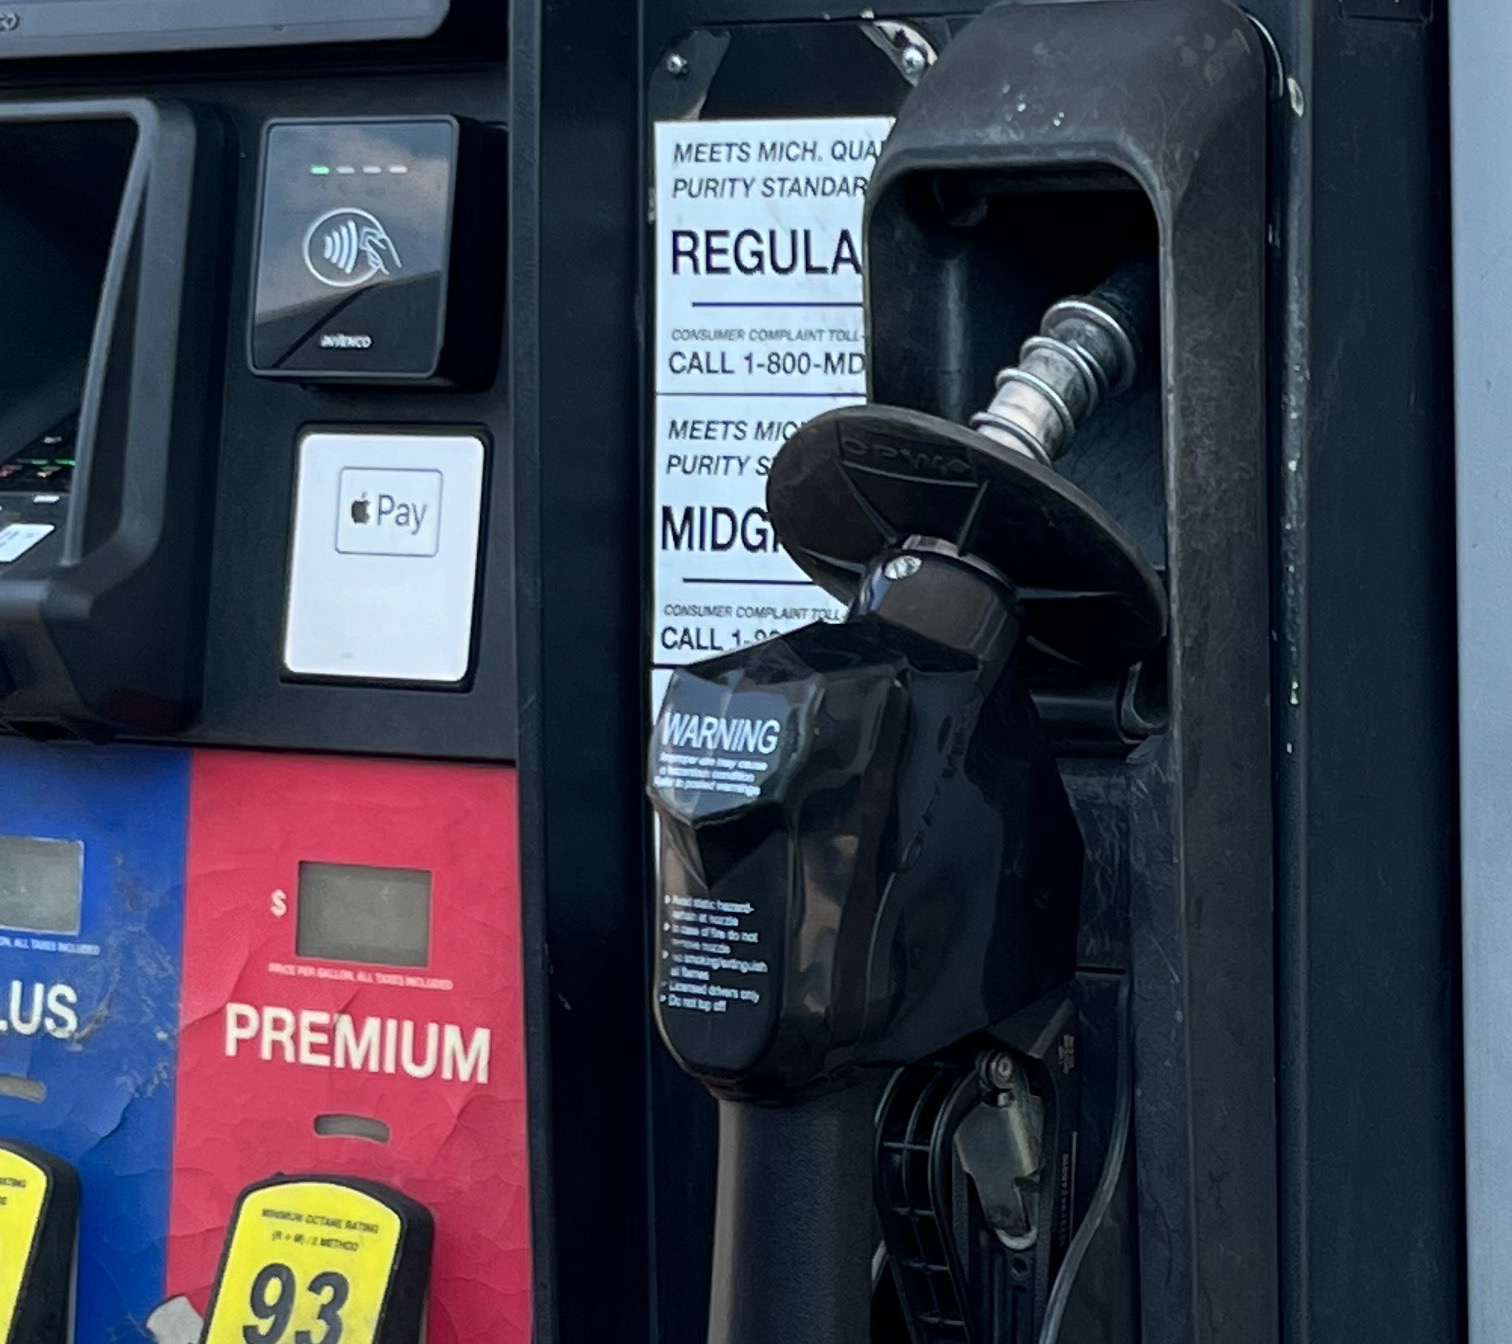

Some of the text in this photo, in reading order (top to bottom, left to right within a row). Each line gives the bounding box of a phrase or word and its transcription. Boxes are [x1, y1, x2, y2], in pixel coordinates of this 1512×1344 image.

[673, 142, 751, 163] MEETS
[758, 141, 823, 162] MICH.
[672, 177, 867, 198] PURITY STANDAR
[671, 229, 862, 275] REGULA
[671, 329, 745, 341] CONSUMER
[750, 329, 825, 341] COMPLAINT
[669, 351, 866, 375] CALL 1-800-MD
[668, 420, 807, 441] MEETS MIC
[665, 455, 750, 475] PURITY
[377, 493, 428, 536] Pay
[661, 505, 779, 553] MIDG
[661, 626, 723, 651] CALL
[662, 712, 780, 754] WARNING
[270, 890, 286, 918] $
[0, 980, 78, 1039] US
[224, 1002, 491, 1085] PREMIUM
[262, 1208, 379, 1233] MINIMUM OCTANE RATING
